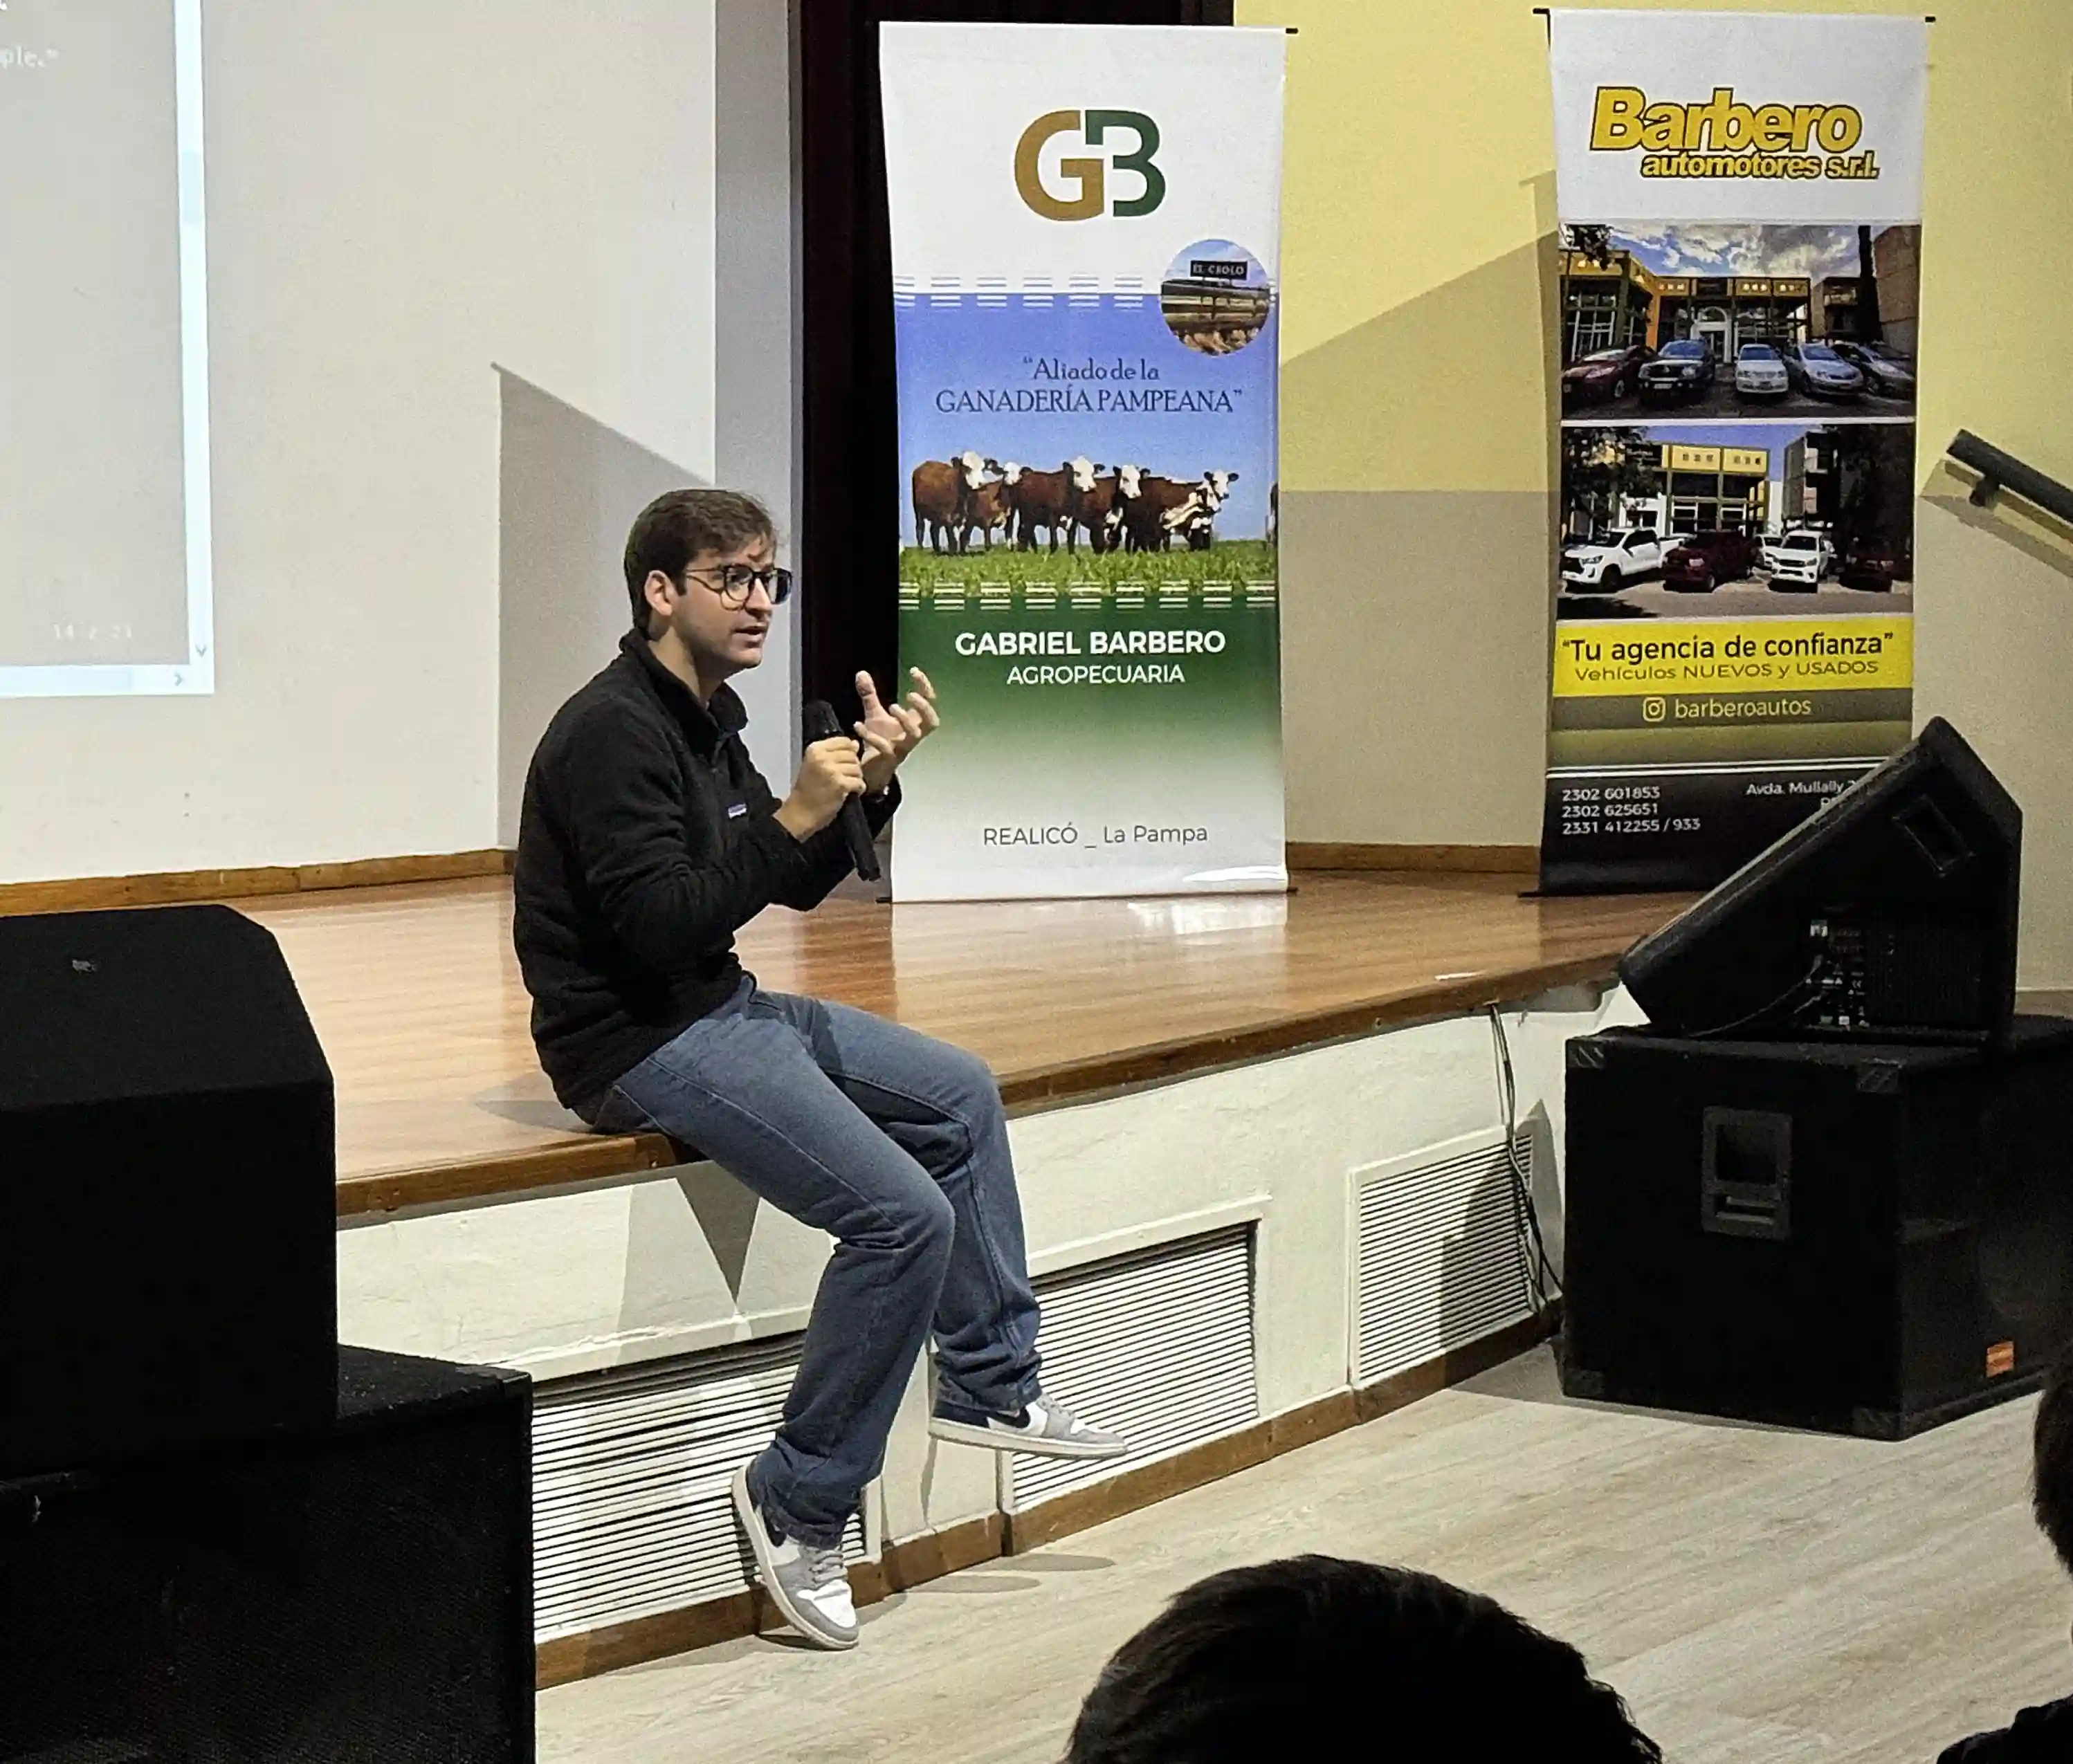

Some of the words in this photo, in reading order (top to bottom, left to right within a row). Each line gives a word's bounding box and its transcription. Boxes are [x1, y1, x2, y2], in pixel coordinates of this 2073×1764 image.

[1590, 86, 1863, 154] Barbero
[1641, 154, 1822, 178] automotores
[1825, 151, 1880, 179] s.r.l.
[1110, 358, 1137, 380] de
[1140, 358, 1160, 380] la
[935, 383, 1095, 413] GANADERÍA
[955, 631, 1081, 656] GABRIEL
[1090, 630, 1226, 654] BARBERO
[1562, 638, 1601, 661] “Tu
[1611, 634, 1715, 665] agencia
[1724, 634, 1756, 658] de
[1764, 631, 1894, 657] confianza”
[1006, 664, 1186, 685] AGROPECUARIA
[1574, 666, 1677, 681] Vehículos
[1683, 663, 1773, 679] NUEVOS
[1778, 665, 1791, 679] y
[1796, 661, 1879, 676] USADOS
[1674, 697, 1812, 719] barberoautos
[1562, 788, 1600, 802] 2302
[1604, 786, 1661, 800] 601853
[1789, 780, 1845, 793] Mullally
[1562, 805, 1600, 818] 2302
[1604, 802, 1659, 817] 625651
[984, 821, 1079, 845] REALICÓ
[1104, 825, 1126, 843] La
[1134, 825, 1208, 845] Pampa
[1562, 821, 1599, 835] 2331
[1605, 819, 1661, 833] 412255
[1672, 817, 1701, 831] 933
